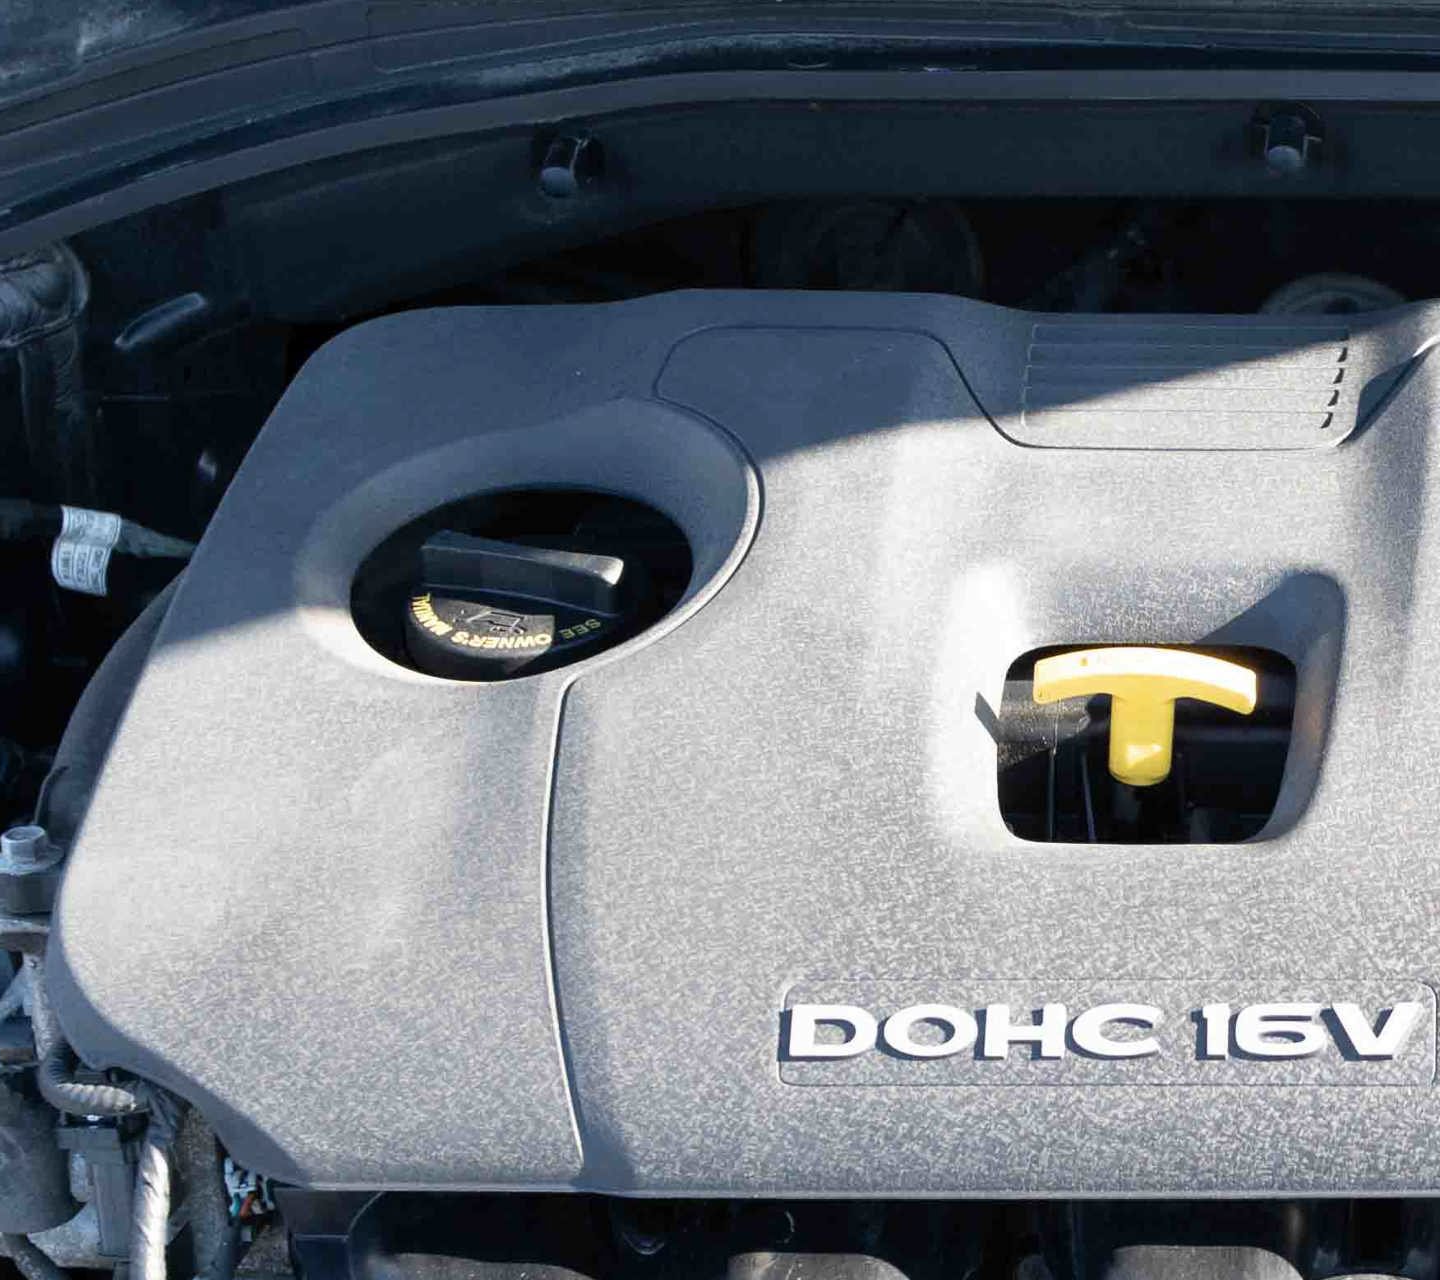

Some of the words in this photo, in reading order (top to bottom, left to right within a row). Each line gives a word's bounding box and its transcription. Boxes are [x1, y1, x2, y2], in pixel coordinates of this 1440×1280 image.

[451, 626, 552, 650] OWNER'S
[560, 618, 601, 641] SEE
[779, 1002, 1161, 1061] DOHC
[1196, 1002, 1424, 1061] 16V
